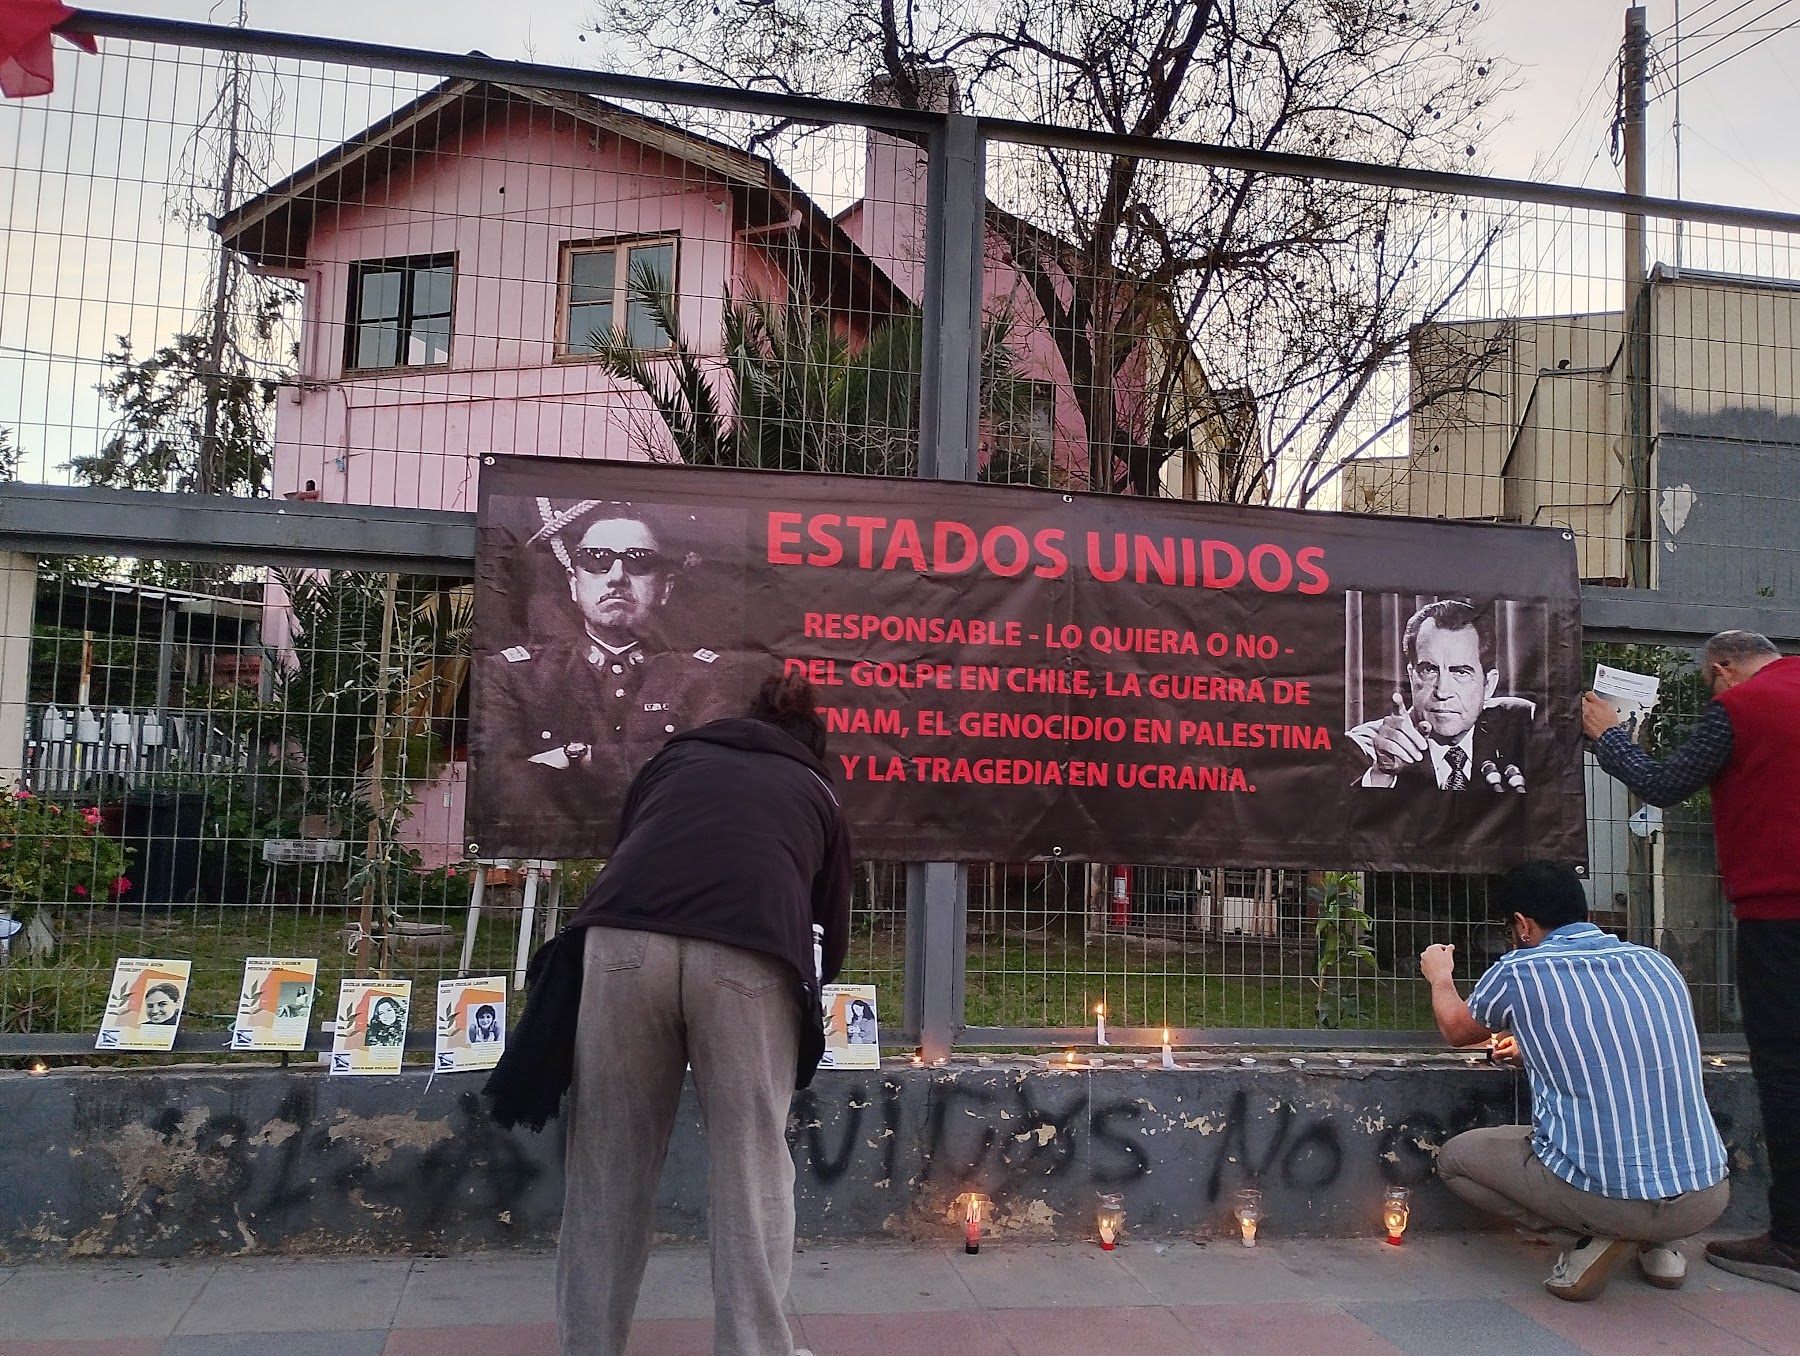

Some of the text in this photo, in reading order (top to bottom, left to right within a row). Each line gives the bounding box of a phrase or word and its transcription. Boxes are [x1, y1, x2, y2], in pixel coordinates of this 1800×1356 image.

[767, 510, 1330, 595] ESTADOS UNIDOS
[804, 611, 1021, 647] RESPONSABLE
[1046, 623, 1083, 649] LO
[1089, 625, 1199, 656] QUIERA
[1206, 632, 1229, 657] O
[1236, 633, 1279, 660] NO
[783, 658, 1311, 706] DEL GOLPE EN CHILE, LA GUERRA DE
[815, 706, 1332, 751] NAM, EL GENOCIDIO EN PALESTINA
[840, 754, 1257, 793] Y LA TRAGEDIA EN UCRANIA.
